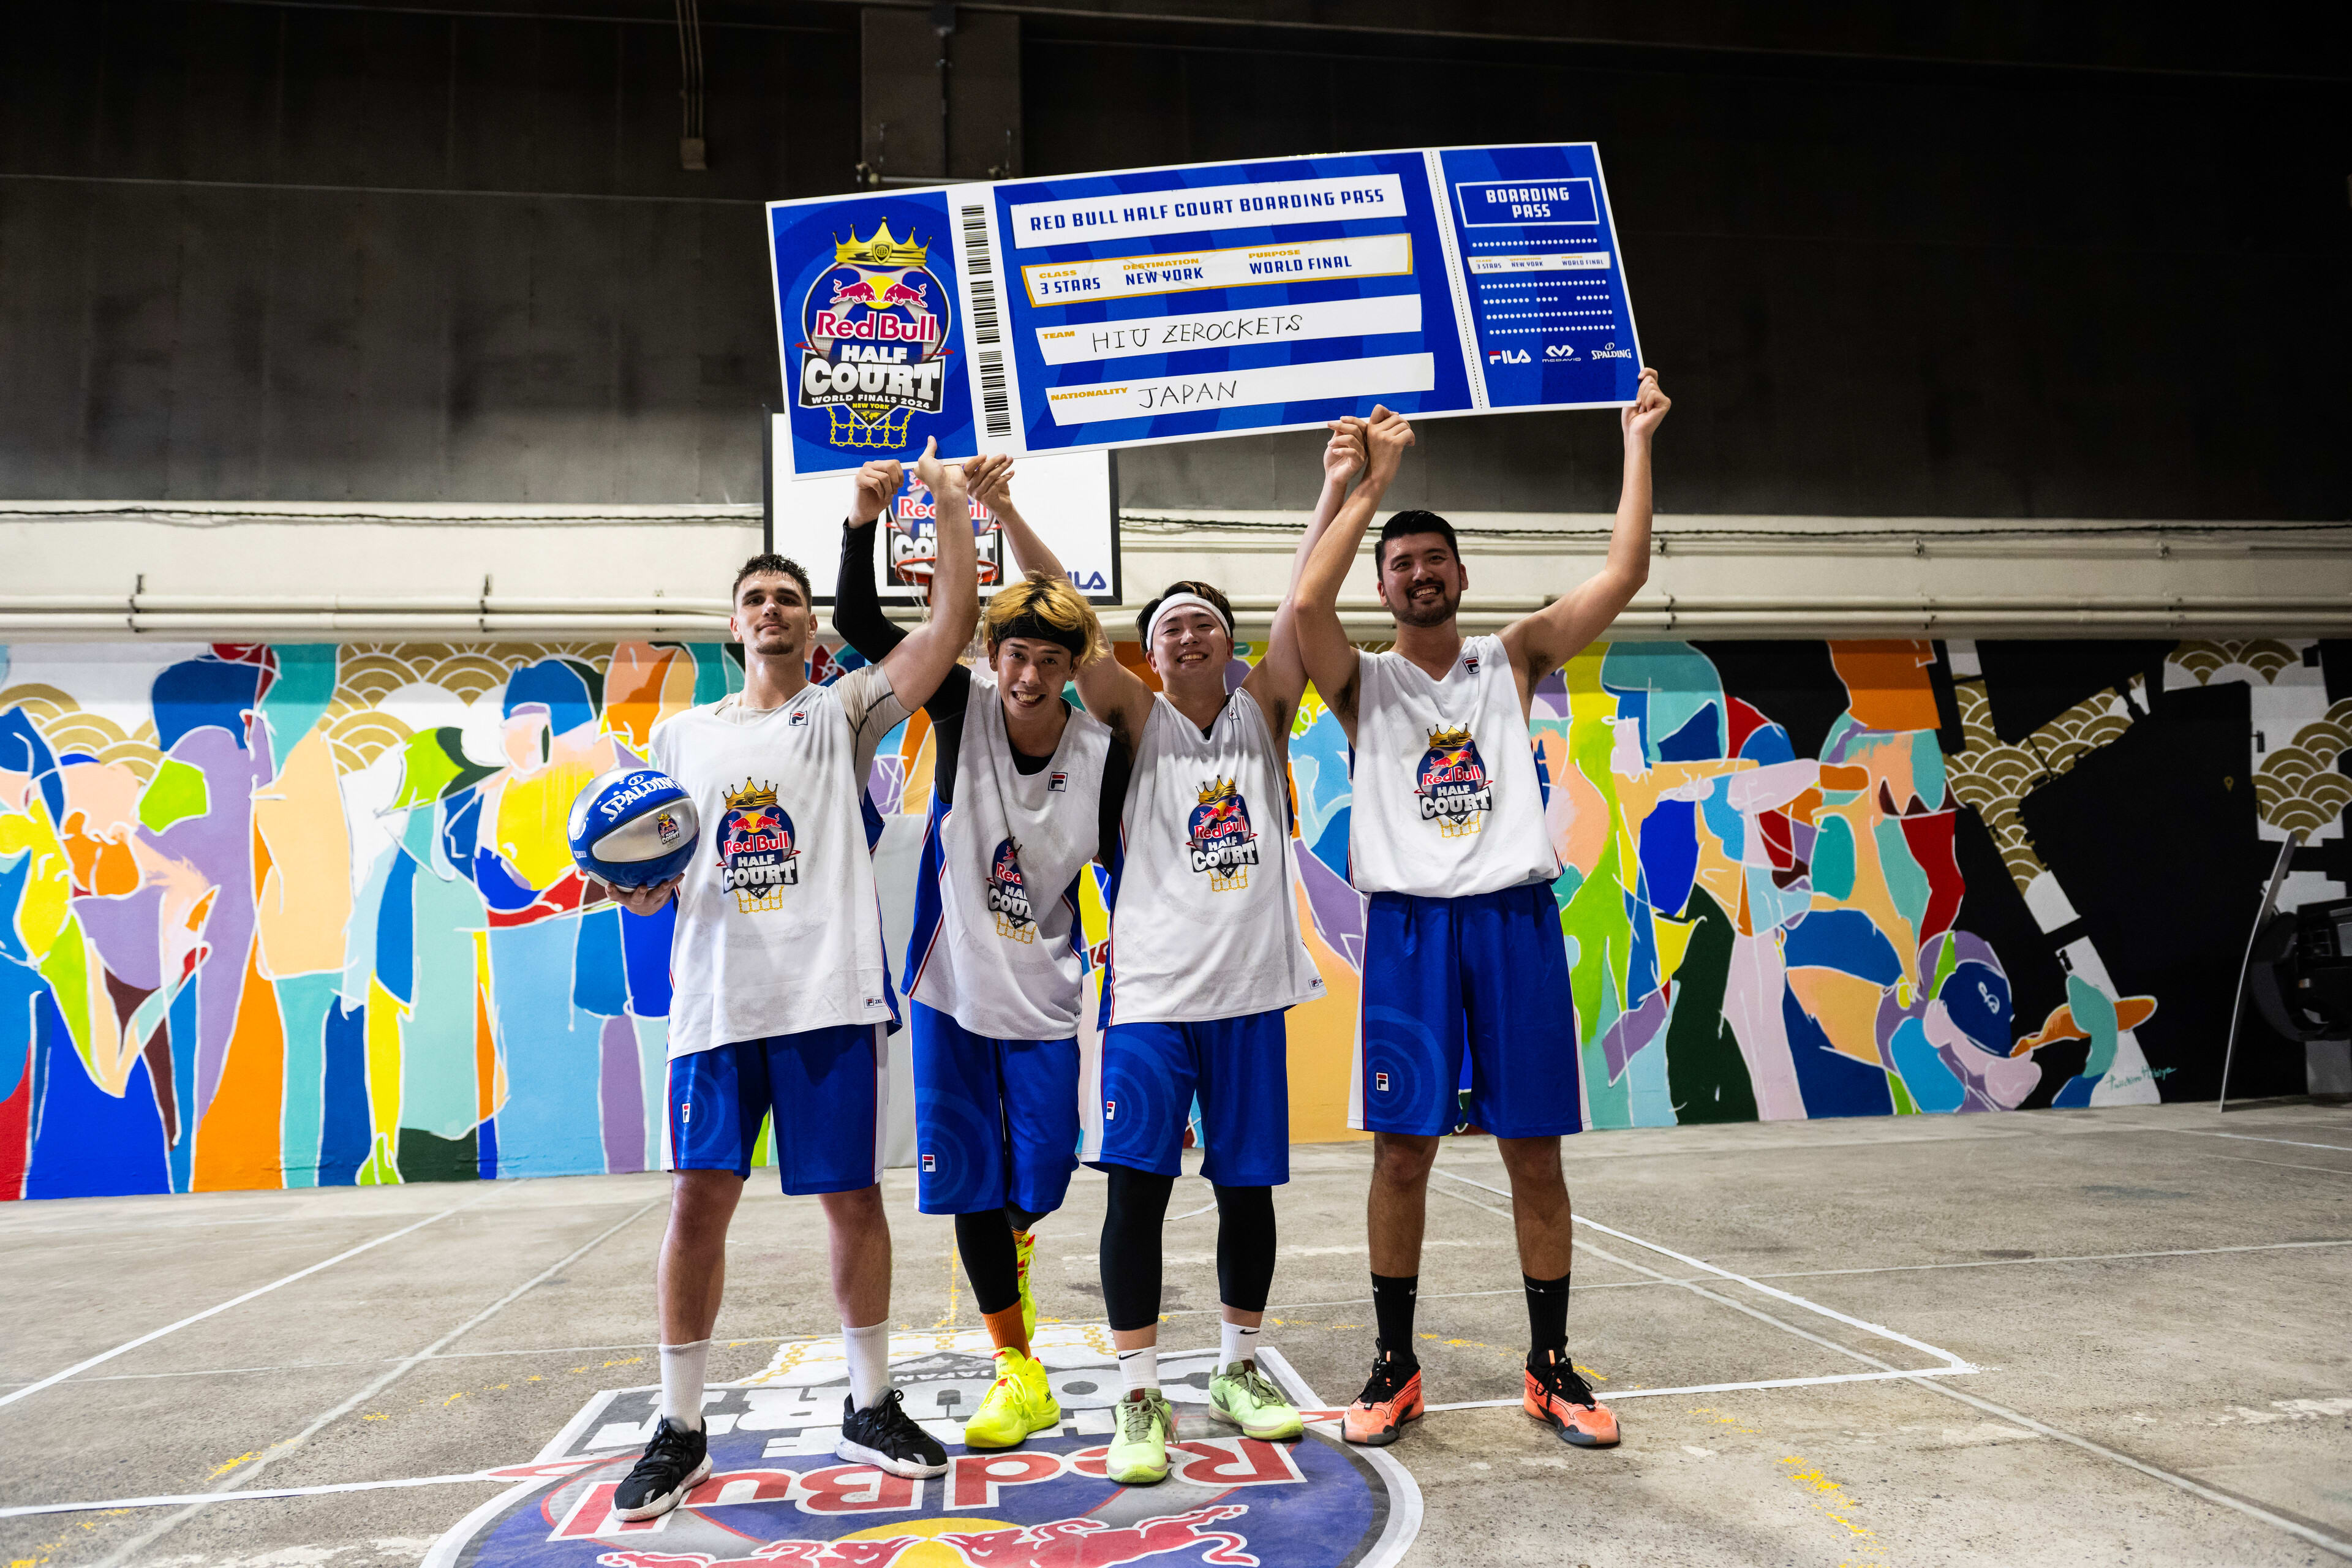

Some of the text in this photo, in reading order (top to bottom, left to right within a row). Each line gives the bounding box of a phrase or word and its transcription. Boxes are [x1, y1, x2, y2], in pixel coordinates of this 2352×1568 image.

[1486, 187, 1570, 203] BOARDING
[1030, 189, 1384, 231] RED BULL HALF COURT BOARDING PASS
[1512, 203, 1551, 218] PASS
[1248, 249, 1301, 259] PURPOSE
[1123, 258, 1199, 270] DESTINATION
[1250, 255, 1352, 275] WORLD FINAL
[1039, 270, 1077, 279] CLASS
[1125, 267, 1204, 286] NEW YORK
[1039, 277, 1101, 295] 3 STARS
[816, 311, 936, 341] Red Bull
[1042, 331, 1076, 339] TEAM
[1092, 314, 1303, 352] HIU ZEROCKETS
[841, 345, 908, 364] HALF
[1488, 349, 1532, 365] FILA
[1591, 349, 1632, 360] SPALDING
[804, 358, 940, 401] COURT
[812, 393, 930, 409] WORLD FINALS 2024
[1050, 387, 1129, 401] NATIONALITY
[1137, 380, 1237, 409] JAPAN
[1423, 765, 1481, 785] Red Bull
[1438, 785, 1470, 796] HALF
[600, 777, 680, 823] SPALDING
[1422, 788, 1491, 818] COURT
[1195, 816, 1246, 839] Red Bull
[725, 832, 788, 854] Red Bull
[1208, 839, 1237, 851] HALF
[737, 854, 775, 867] HALF
[1193, 843, 1256, 871] COURT
[724, 859, 796, 892] COURT
[893, 1370, 992, 1382] JAPAN
